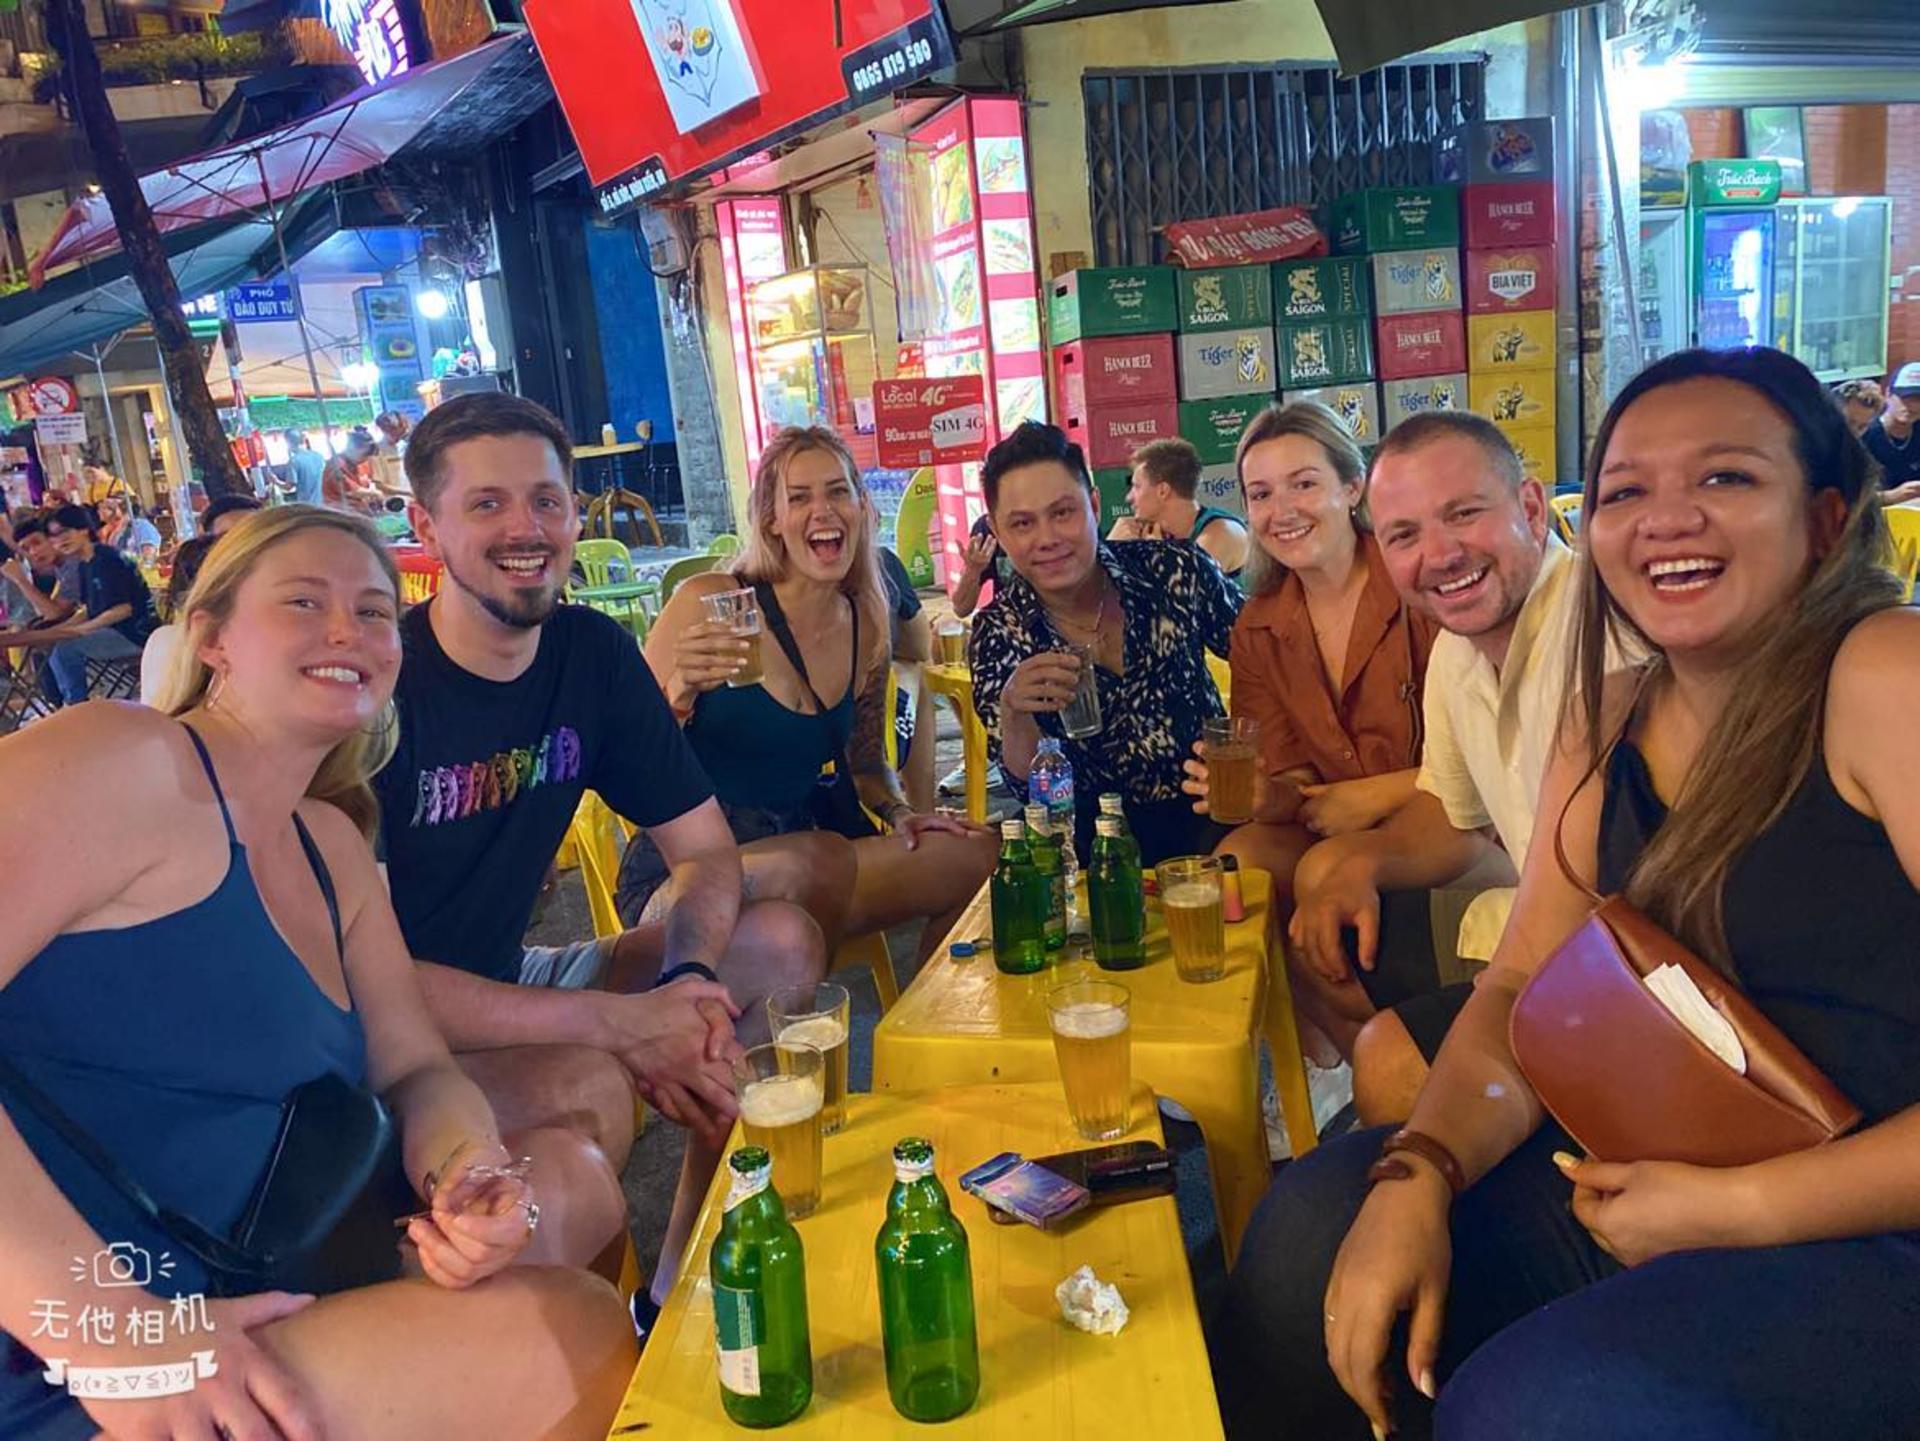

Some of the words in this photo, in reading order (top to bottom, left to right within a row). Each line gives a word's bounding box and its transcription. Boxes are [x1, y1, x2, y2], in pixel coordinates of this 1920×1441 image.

[853, 61, 883, 92] 0865
[905, 38, 932, 68] 580
[1388, 263, 1422, 285] Tiger
[1492, 274, 1510, 290] BIA
[257, 301, 278, 316] DUY
[1285, 303, 1326, 316] SAIGON
[1190, 311, 1229, 324] SAIGON
[1132, 354, 1152, 369] BEER
[1197, 345, 1235, 366] Tiger
[881, 387, 917, 404] Local
[920, 386, 946, 406] 4G
[1399, 392, 1431, 411] Tiger
[933, 418, 960, 432] SIM
[964, 417, 984, 430] 4G
[1137, 420, 1157, 435] BEER
[1202, 476, 1237, 496] Tiger
